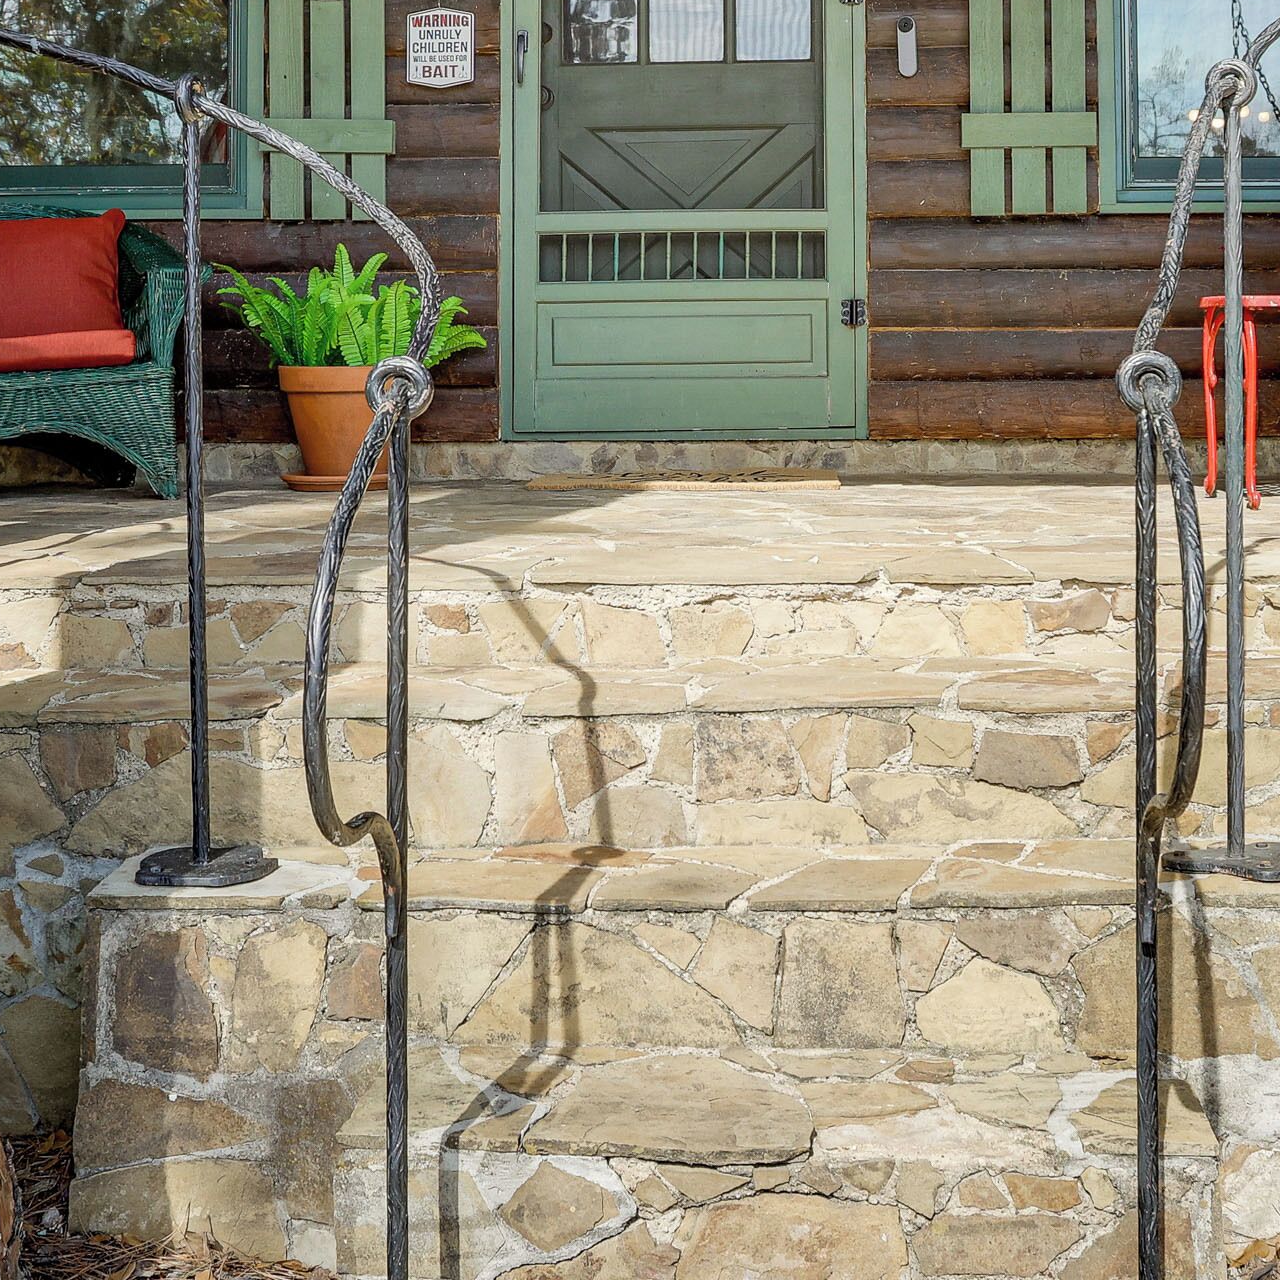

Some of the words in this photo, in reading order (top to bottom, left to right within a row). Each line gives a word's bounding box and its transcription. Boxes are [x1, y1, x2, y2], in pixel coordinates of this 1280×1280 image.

[412, 14, 470, 28] WARNING
[418, 29, 462, 40] UNRULY
[412, 42, 468, 54] CHILDREN
[422, 65, 458, 78] BAIT
